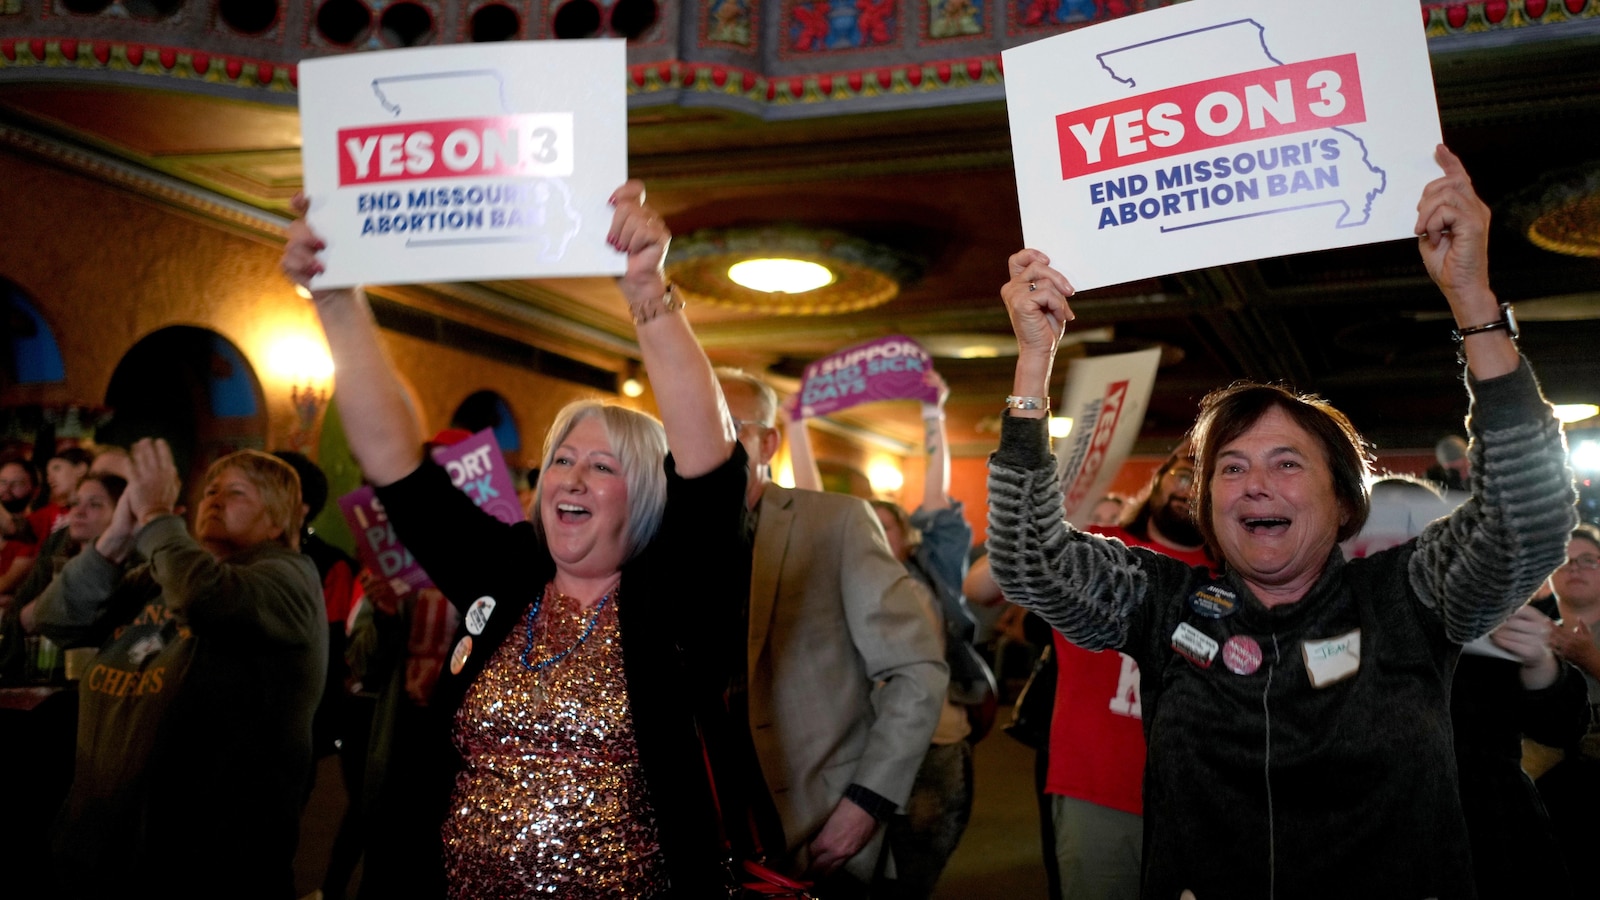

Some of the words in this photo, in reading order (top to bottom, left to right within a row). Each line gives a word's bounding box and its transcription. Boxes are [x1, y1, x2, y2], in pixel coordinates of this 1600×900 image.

[1068, 102, 1185, 165] YES
[1194, 79, 1296, 137] ON
[1306, 70, 1346, 117] 3
[345, 130, 435, 179] YES
[442, 127, 519, 171] ON
[530, 126, 559, 165] 3
[1090, 174, 1149, 205] END
[1155, 137, 1341, 191] MISSOURI'S
[357, 189, 402, 215] END
[407, 181, 550, 210] MISSOURI
[1098, 177, 1260, 230] ABORTION
[1266, 165, 1340, 197] BAN
[360, 208, 483, 238] ABORTION
[821, 342, 929, 375] SUPPORT
[867, 357, 924, 376] SICK
[801, 376, 866, 405] DAYS
